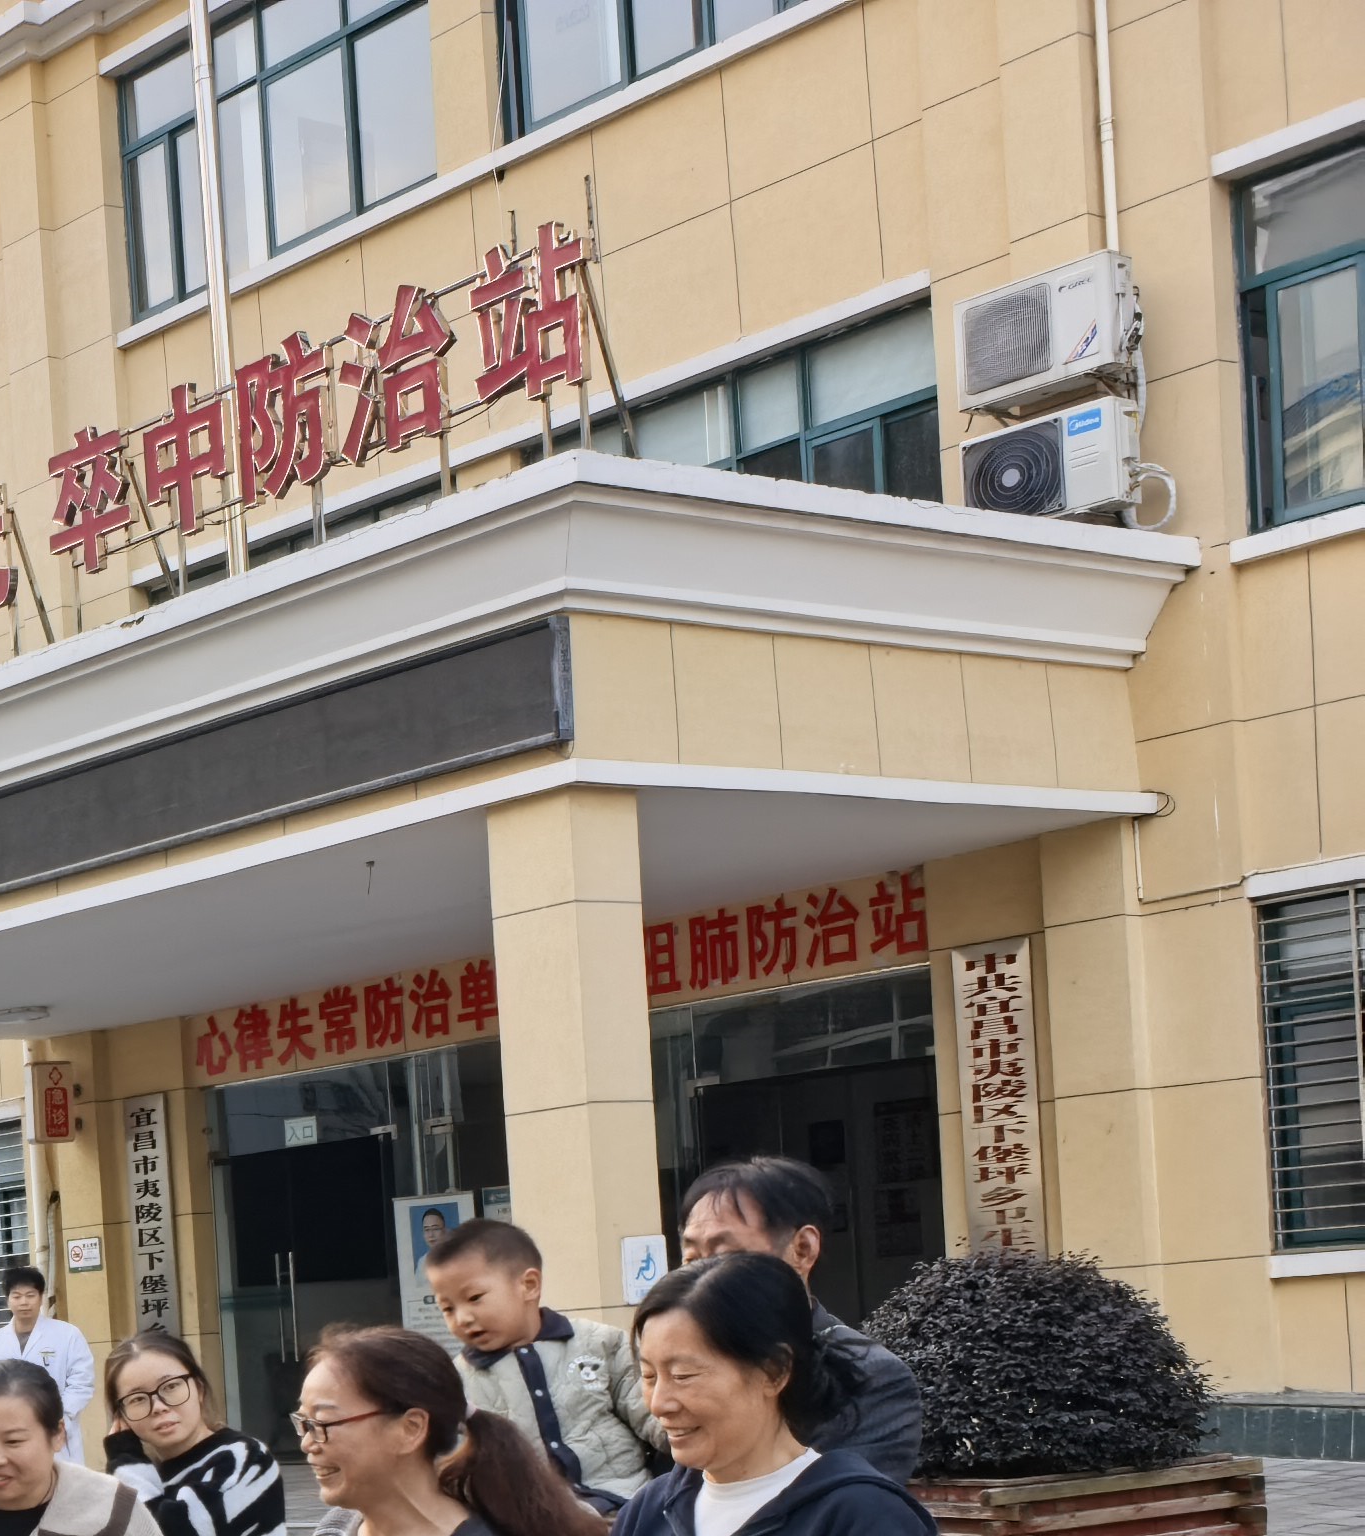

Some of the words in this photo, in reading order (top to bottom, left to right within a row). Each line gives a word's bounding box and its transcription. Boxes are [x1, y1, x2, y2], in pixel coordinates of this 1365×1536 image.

[48, 221, 590, 573] 卒中防治站
[52, 1088, 66, 1125] 急诊
[288, 1125, 313, 1142] 入口
[963, 953, 1036, 1253] 中共宜昌市夷陵区下堡坪乡卫生
